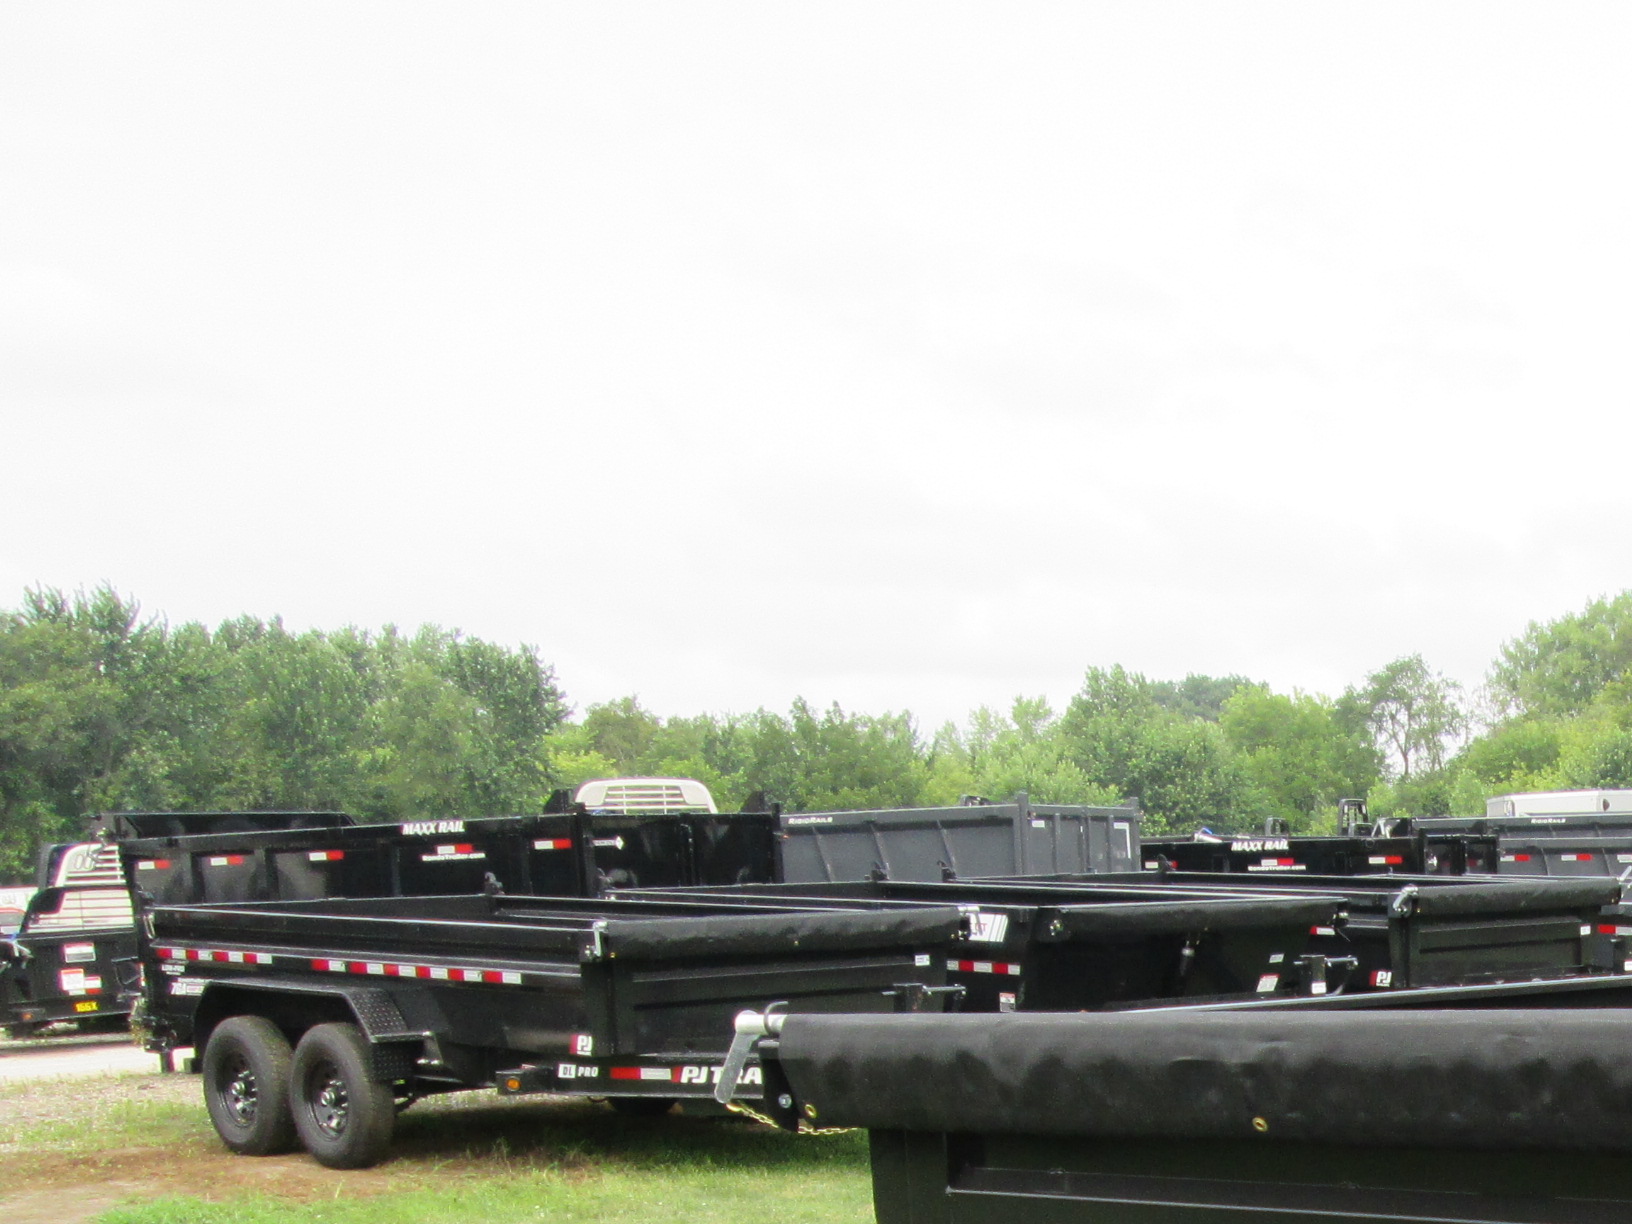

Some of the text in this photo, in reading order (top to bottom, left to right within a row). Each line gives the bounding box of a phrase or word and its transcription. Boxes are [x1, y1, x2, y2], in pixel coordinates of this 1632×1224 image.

[402, 820, 466, 836] MAXX RAIL
[1230, 838, 1290, 852] MAXX RAIL
[1376, 971, 1392, 983] PJ
[576, 1035, 593, 1051] PJ
[577, 1065, 600, 1078] PRO
